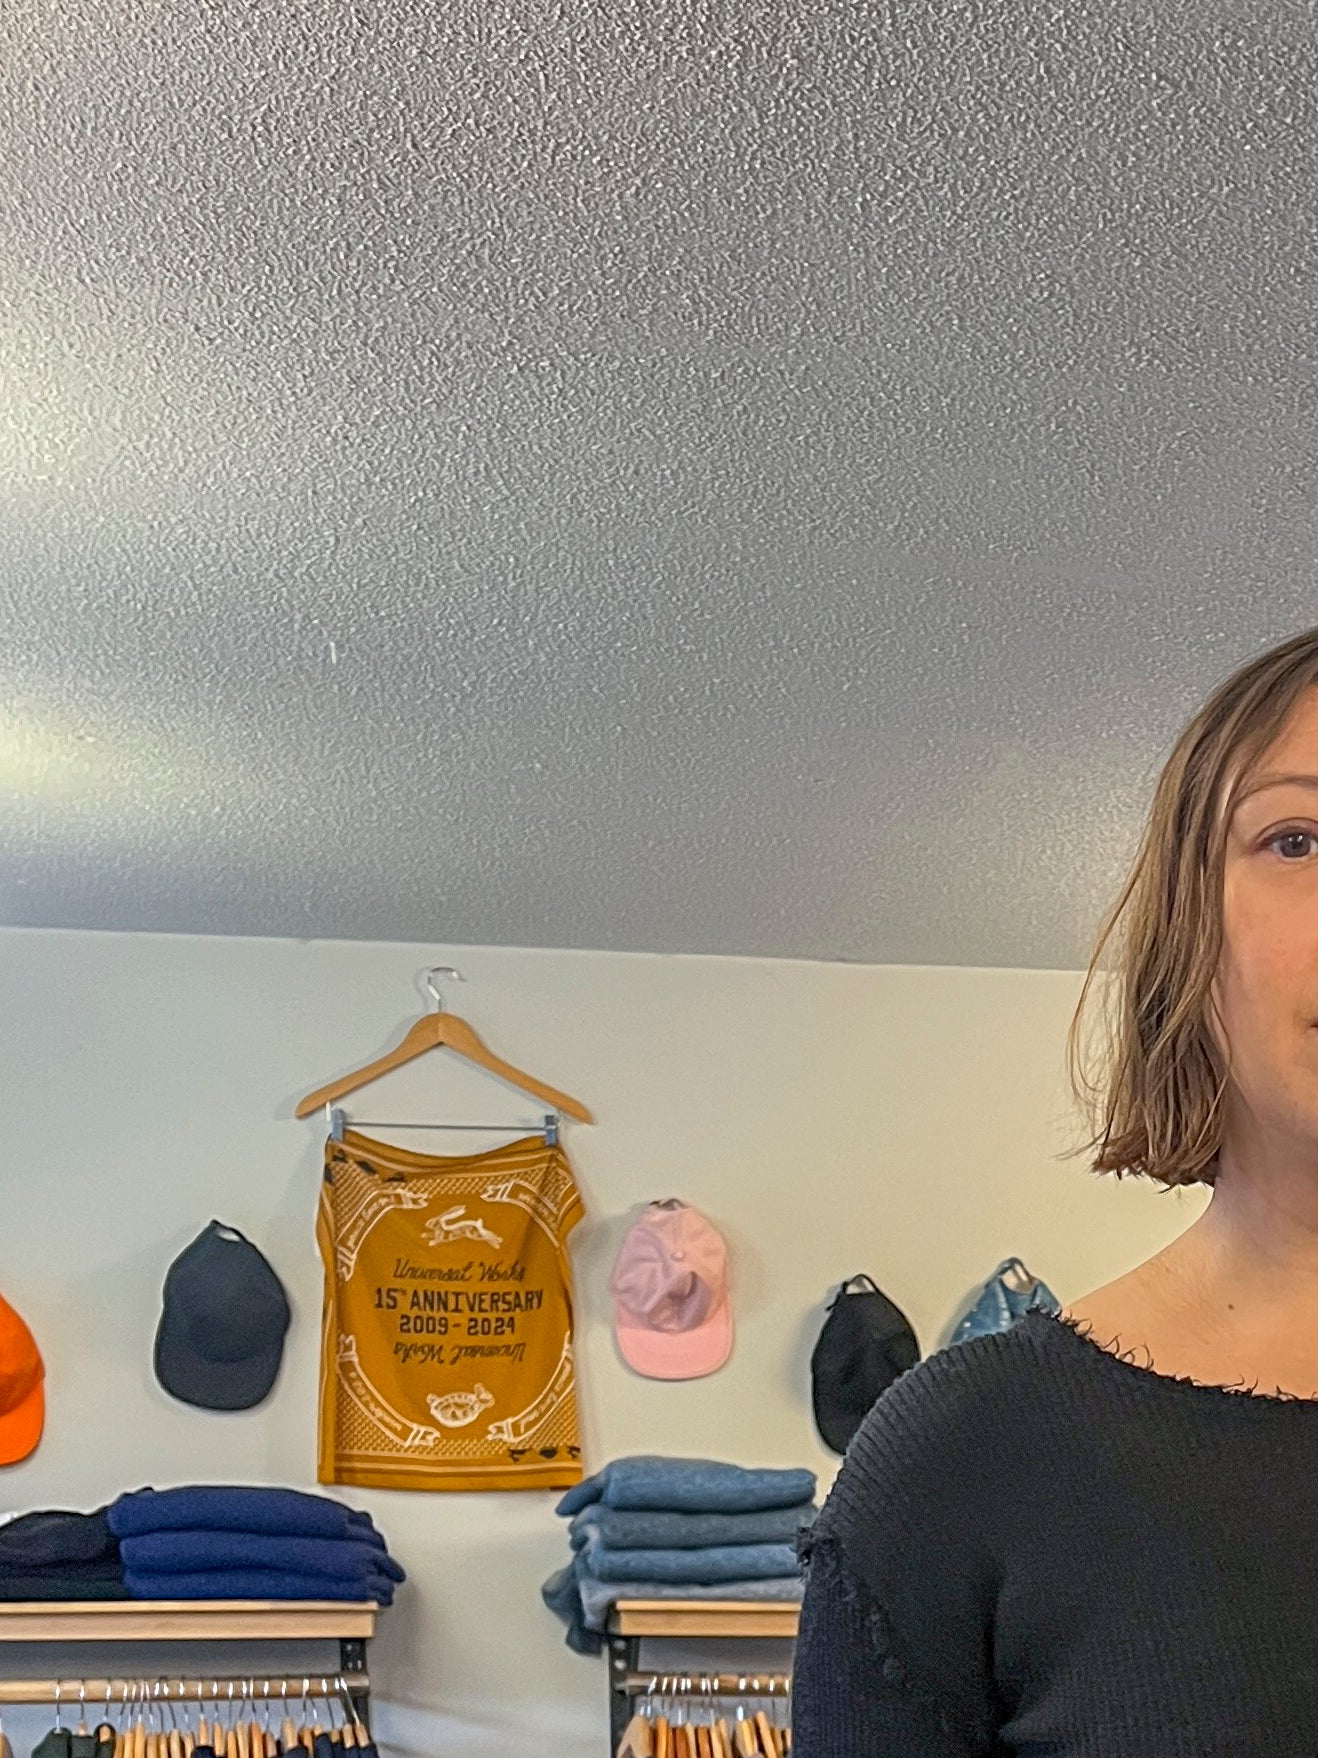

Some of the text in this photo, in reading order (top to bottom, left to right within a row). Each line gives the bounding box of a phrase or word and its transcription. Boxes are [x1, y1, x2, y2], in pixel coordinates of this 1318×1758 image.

[393, 1257, 526, 1282] Universal Works
[410, 1289, 544, 1313] ANNIVERSARY
[399, 1314, 449, 1336] 2009
[467, 1316, 515, 1336] 2024
